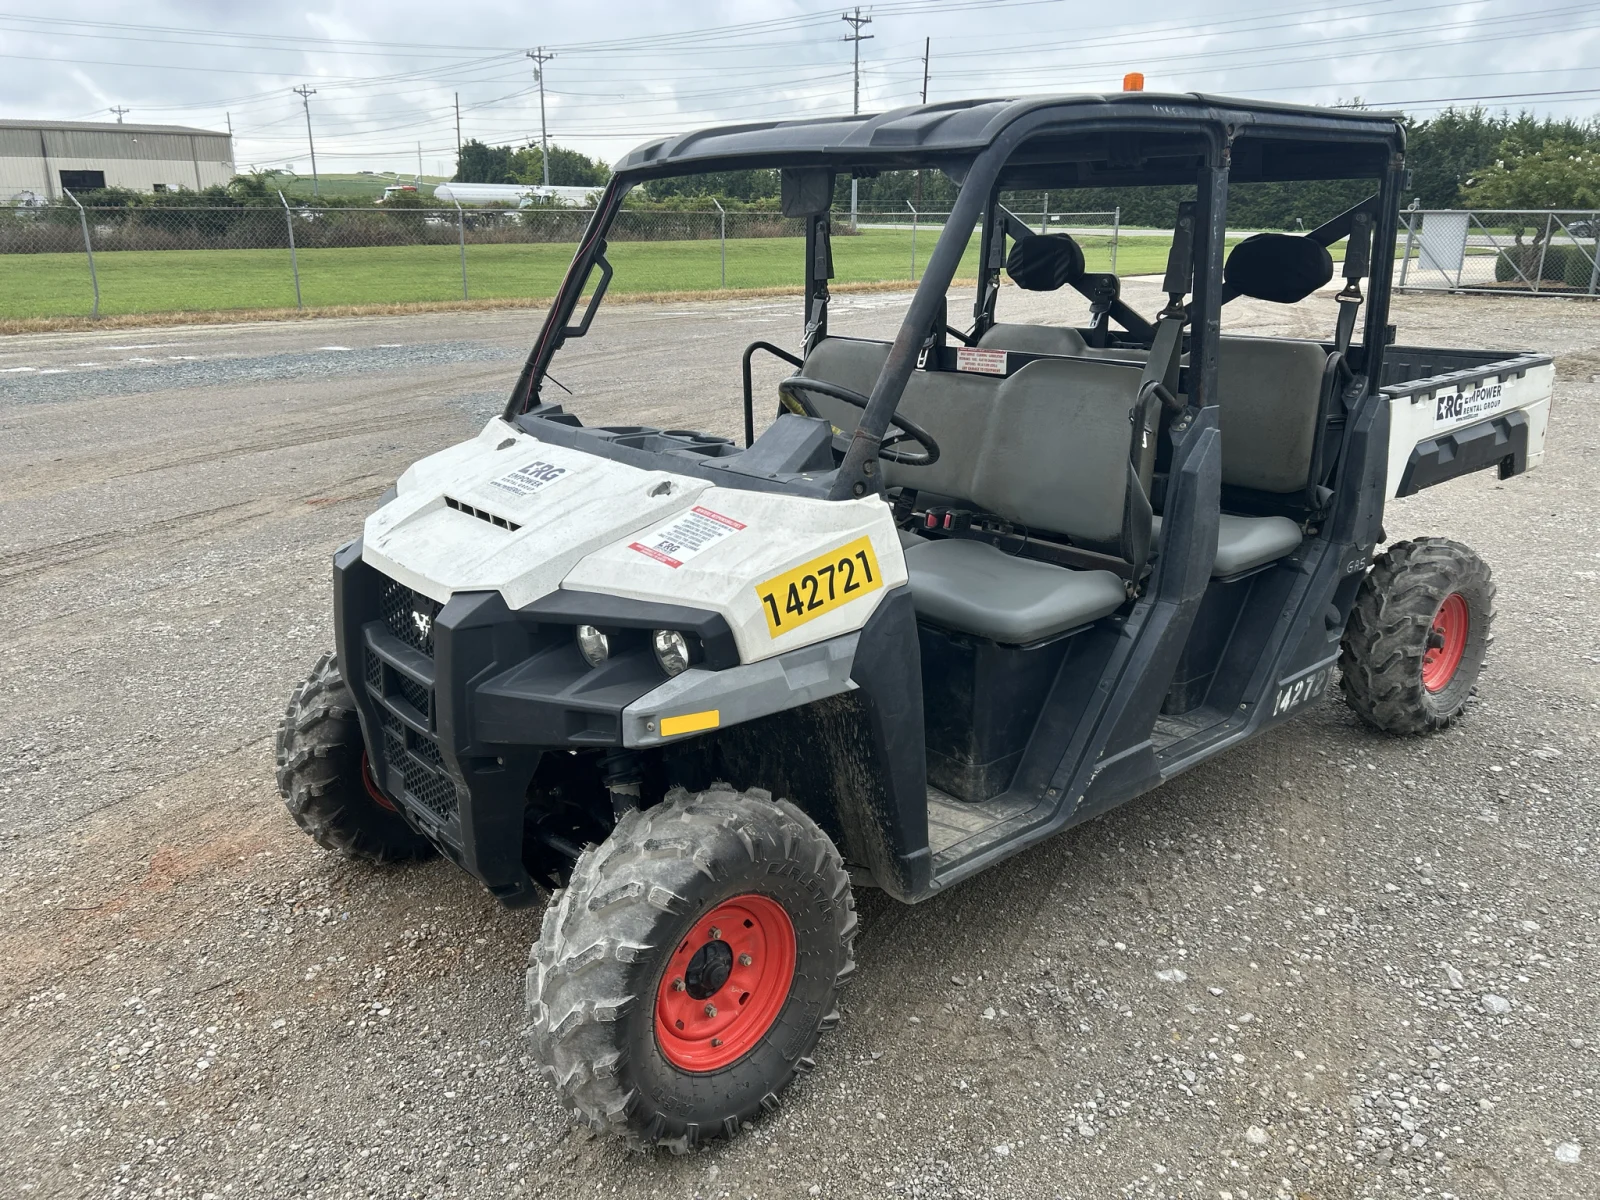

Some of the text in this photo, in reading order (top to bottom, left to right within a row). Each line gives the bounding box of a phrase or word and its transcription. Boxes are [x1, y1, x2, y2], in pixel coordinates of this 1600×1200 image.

[1464, 385, 1502, 405] EMPOWER
[1436, 393, 1464, 421] ERG
[1463, 399, 1501, 415] RENTAL GROUP
[507, 472, 544, 488] EMPOWER
[517, 461, 566, 482] ERG
[658, 540, 681, 553] ERG
[1346, 557, 1366, 574] GAS
[762, 549, 873, 627] 142721
[765, 861, 833, 924] CARLSTAR
